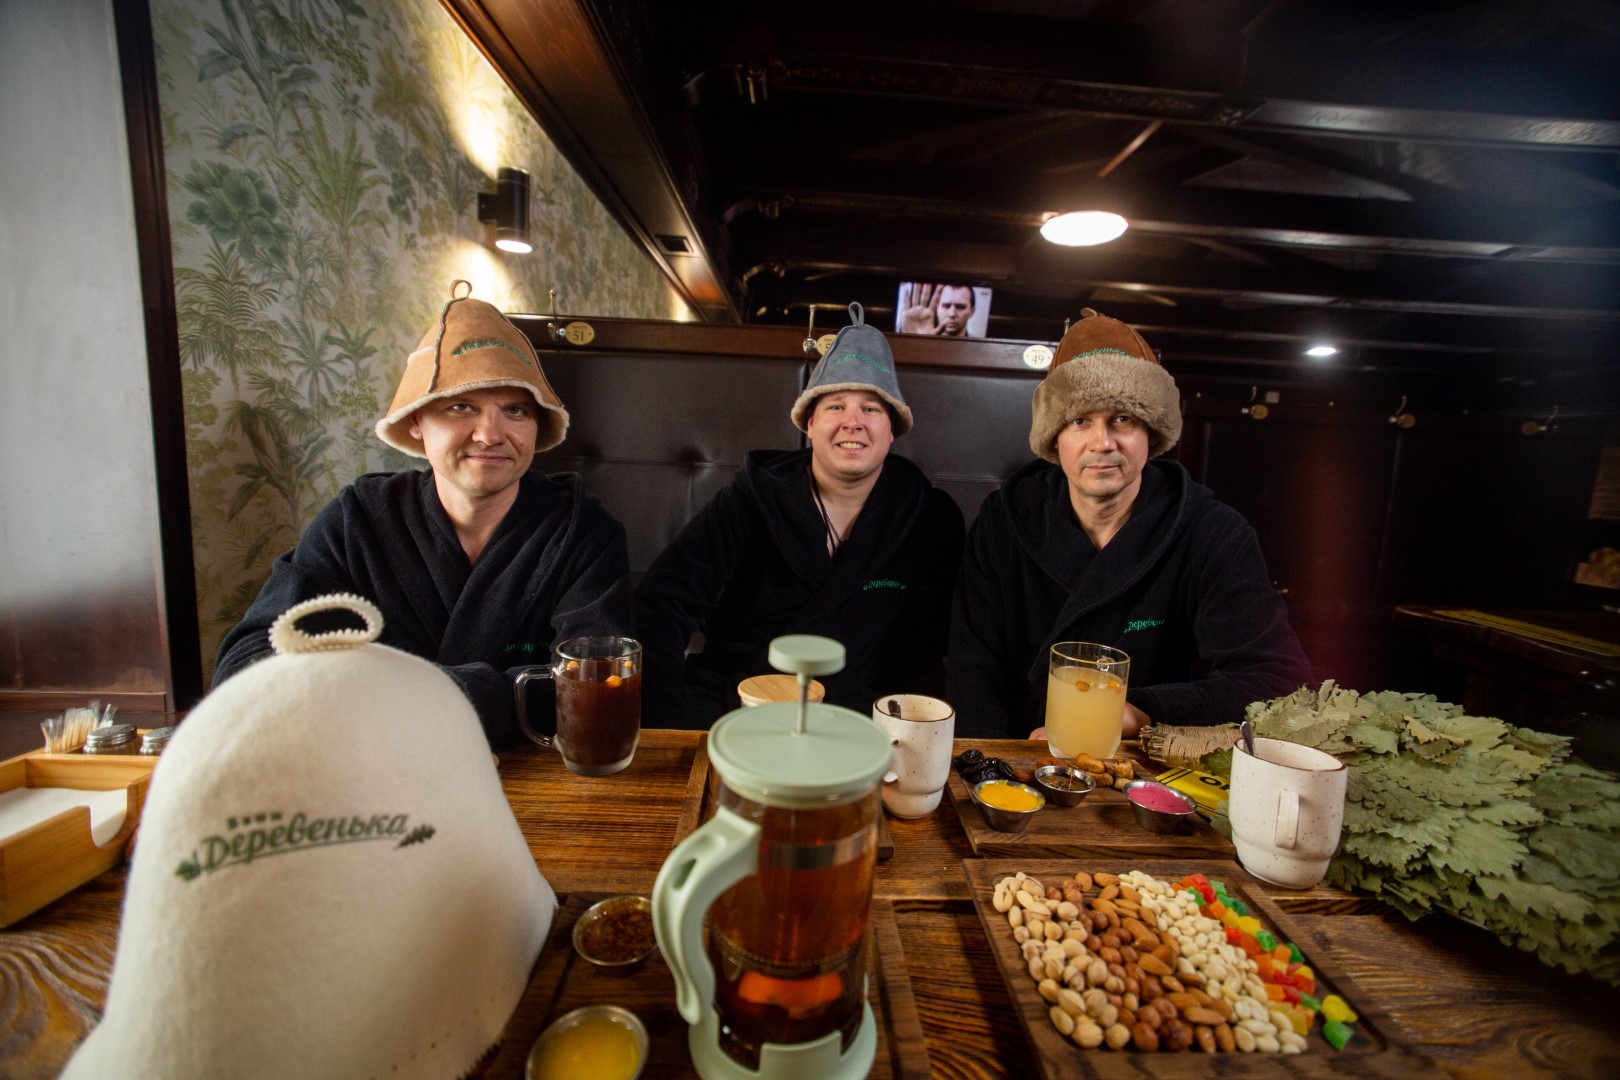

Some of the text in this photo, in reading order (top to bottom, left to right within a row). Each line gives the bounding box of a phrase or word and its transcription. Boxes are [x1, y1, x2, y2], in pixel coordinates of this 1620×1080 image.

[573, 330, 585, 341] 51
[1031, 354, 1044, 364] 49
[201, 812, 408, 868] Деревенька
